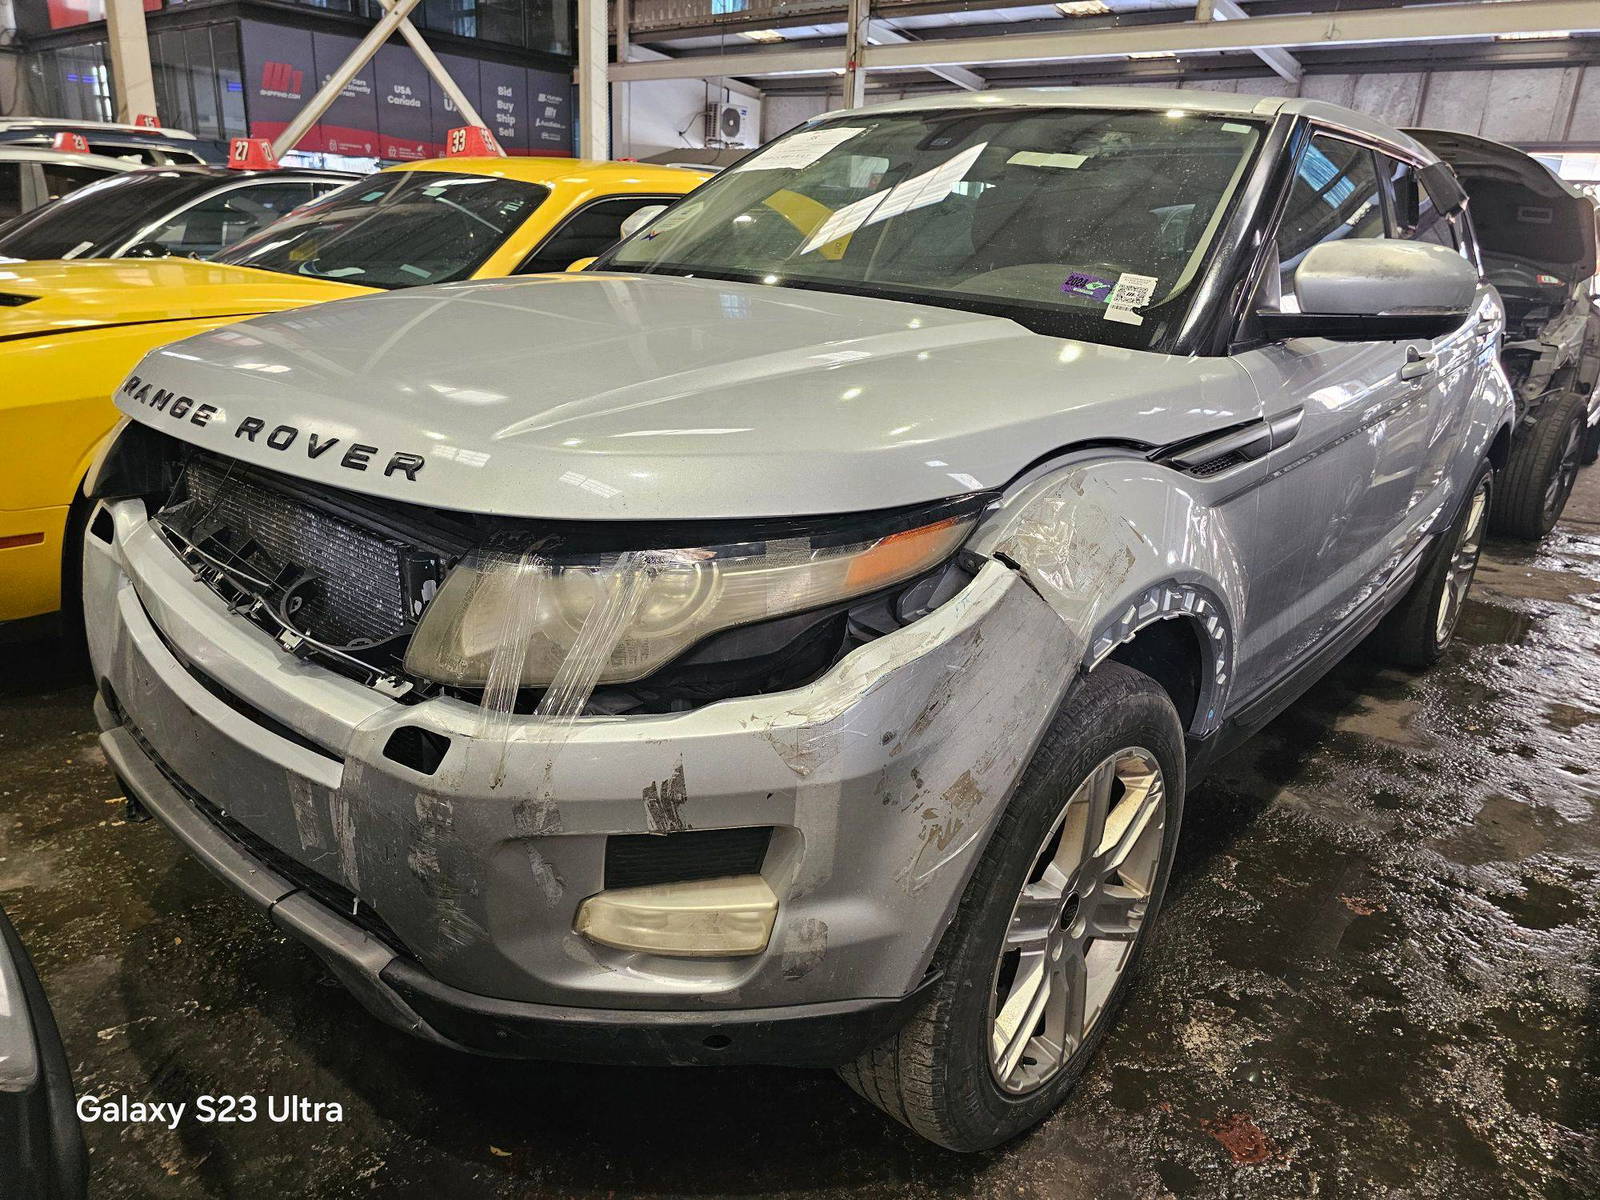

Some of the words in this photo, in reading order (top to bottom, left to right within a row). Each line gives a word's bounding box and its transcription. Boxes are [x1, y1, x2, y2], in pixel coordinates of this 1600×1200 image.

[393, 85, 412, 96] USA
[497, 86, 513, 97] Bid
[387, 95, 421, 108] Canada
[496, 100, 514, 113] Buy
[496, 113, 516, 127] Ship
[498, 127, 515, 137] Sell
[452, 129, 466, 153] 33
[235, 140, 249, 161] 27
[123, 375, 218, 428] RANGE
[234, 416, 426, 482] ROVER
